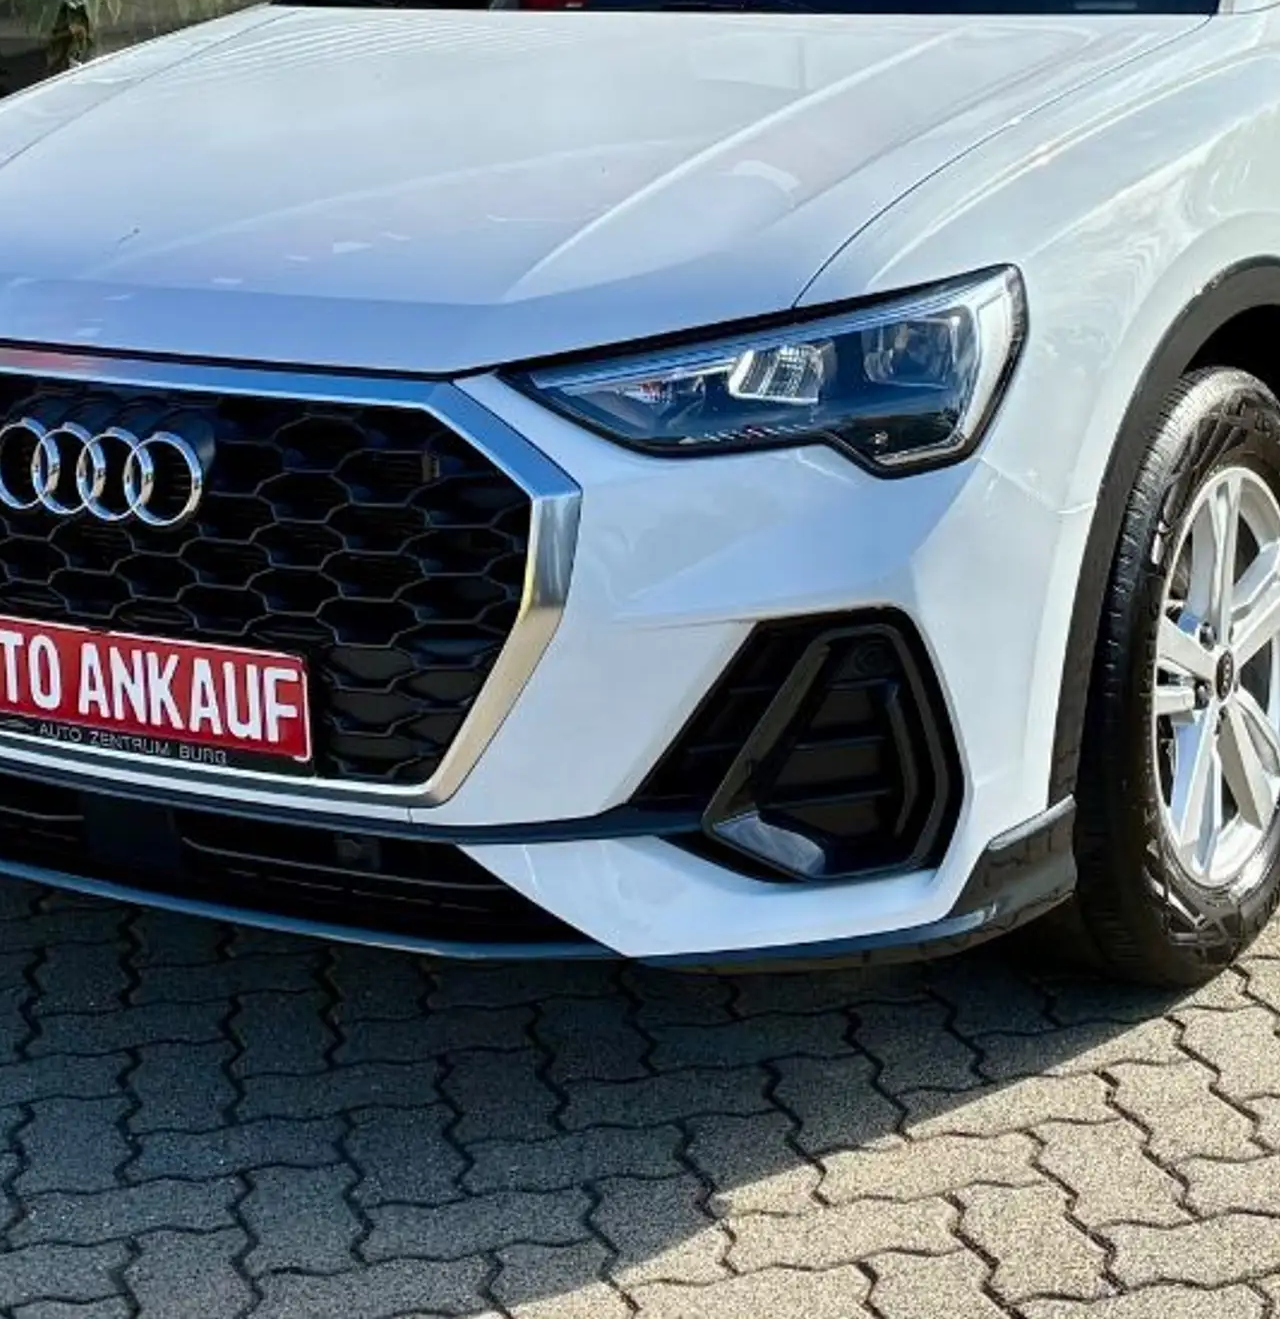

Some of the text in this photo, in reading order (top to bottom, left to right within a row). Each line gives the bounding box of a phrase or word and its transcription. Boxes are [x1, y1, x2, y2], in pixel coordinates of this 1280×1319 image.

[78, 641, 298, 743] ANKAUF
[39, 723, 227, 764] AUTO ZENTRUM BURG
